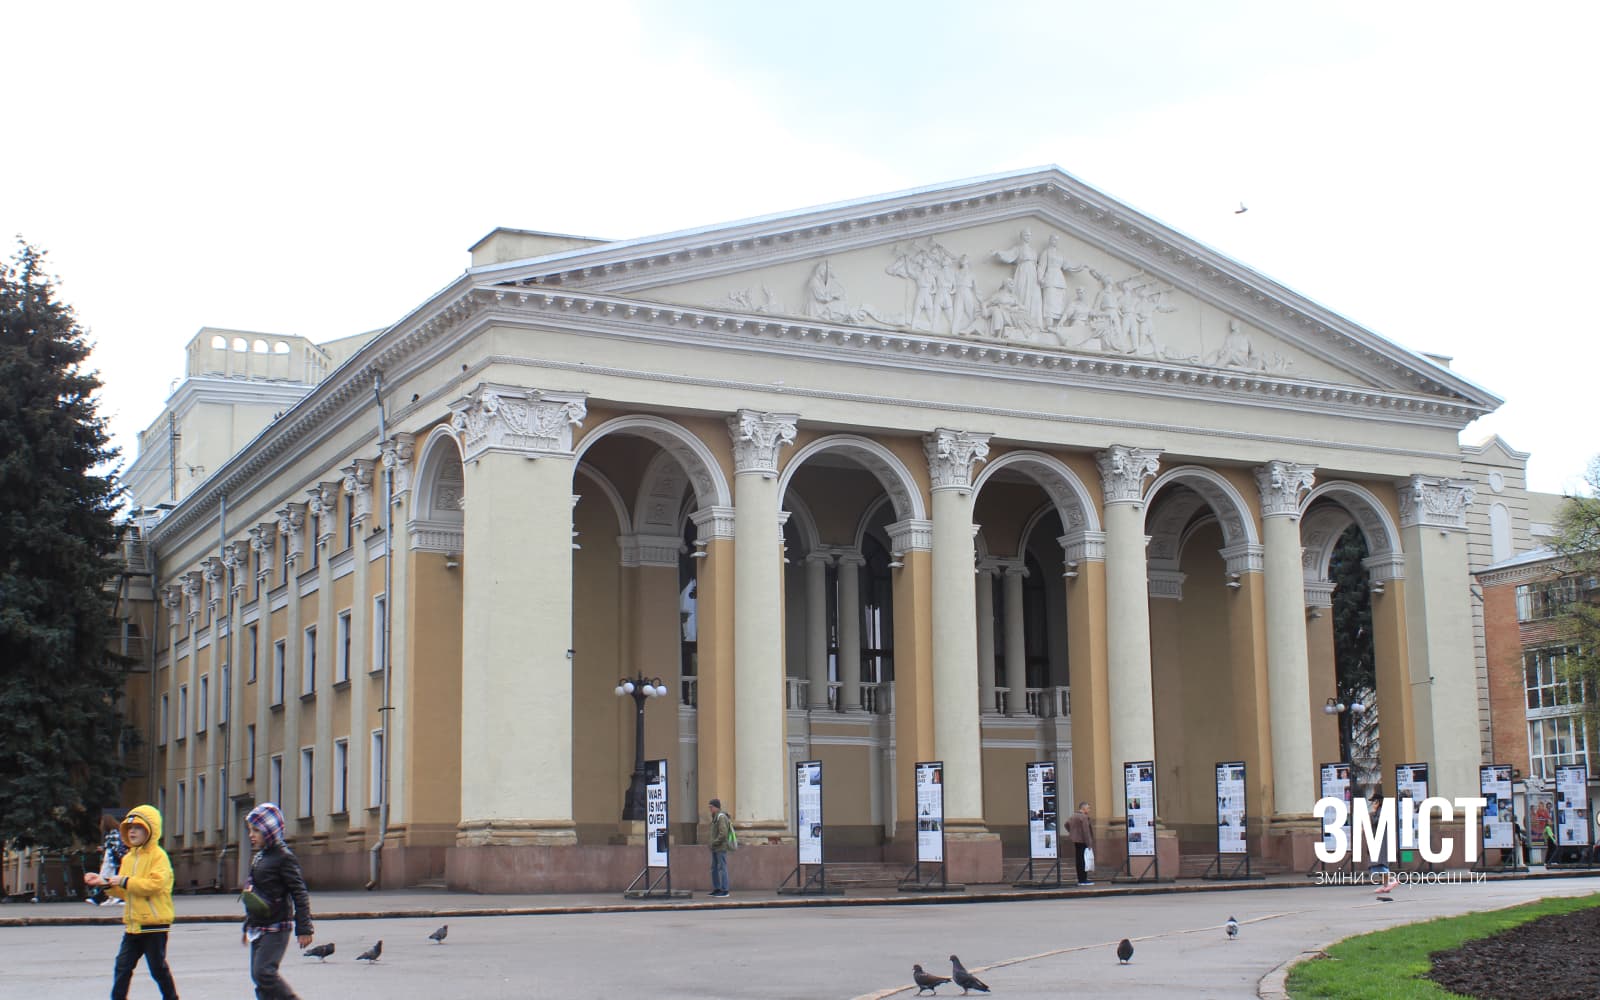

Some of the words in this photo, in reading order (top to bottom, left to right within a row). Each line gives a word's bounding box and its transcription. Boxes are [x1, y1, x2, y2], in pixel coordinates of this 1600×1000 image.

[648, 789, 662, 799] WAR
[649, 802, 655, 812] IS
[656, 801, 666, 812] NOT
[648, 814, 665, 824] OVER
